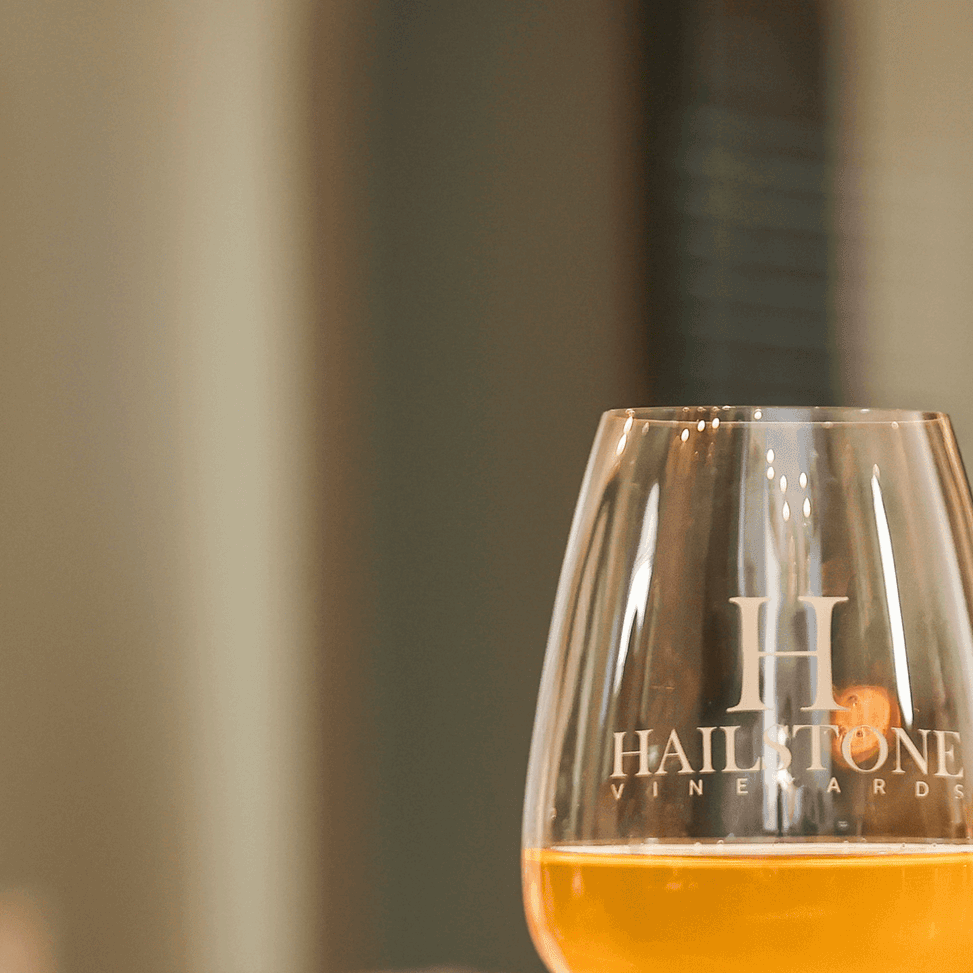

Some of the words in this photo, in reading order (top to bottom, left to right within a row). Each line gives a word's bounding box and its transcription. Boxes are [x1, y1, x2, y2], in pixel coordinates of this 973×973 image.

[726, 596, 849, 713] H
[609, 724, 965, 779] HAILSTONE
[610, 777, 965, 800] VINEARDS
